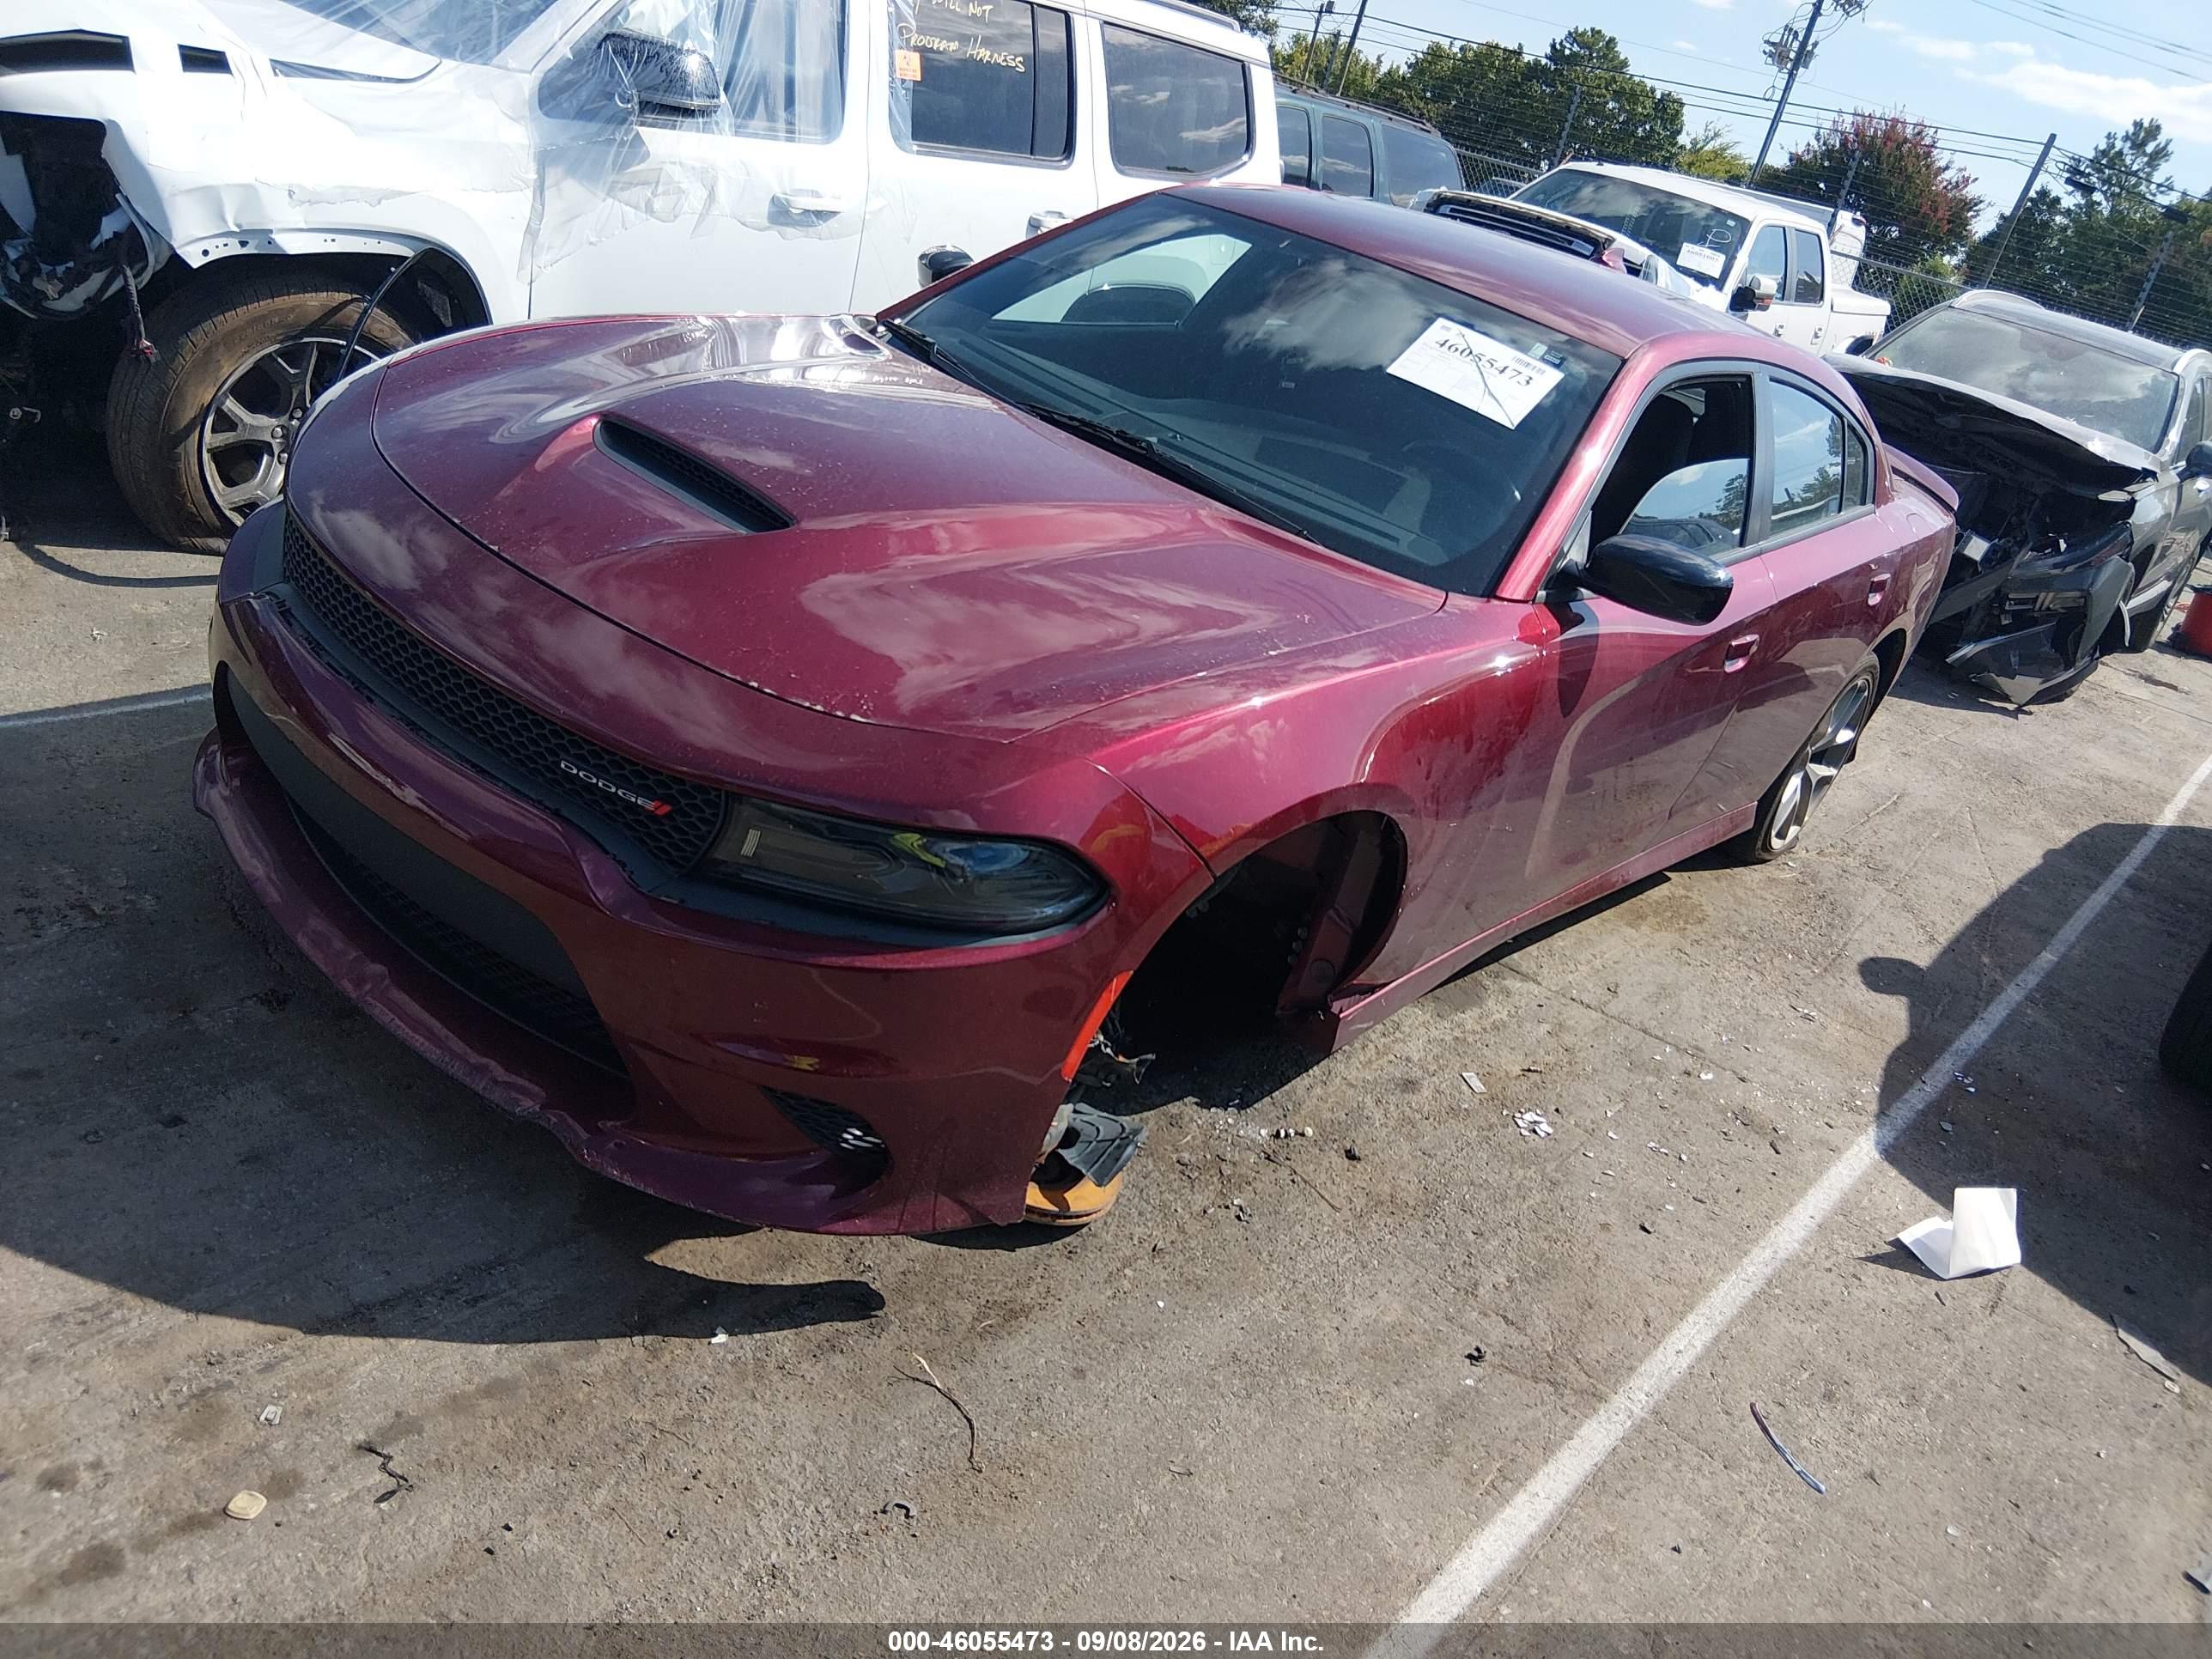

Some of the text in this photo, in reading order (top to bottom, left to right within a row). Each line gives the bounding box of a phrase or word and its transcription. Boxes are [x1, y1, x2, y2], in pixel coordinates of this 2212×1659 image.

[968, 1, 994, 23] NOT
[966, 34, 1025, 72] HARNESS
[1435, 338, 1534, 386] 46055473
[560, 760, 656, 811] DODGE
